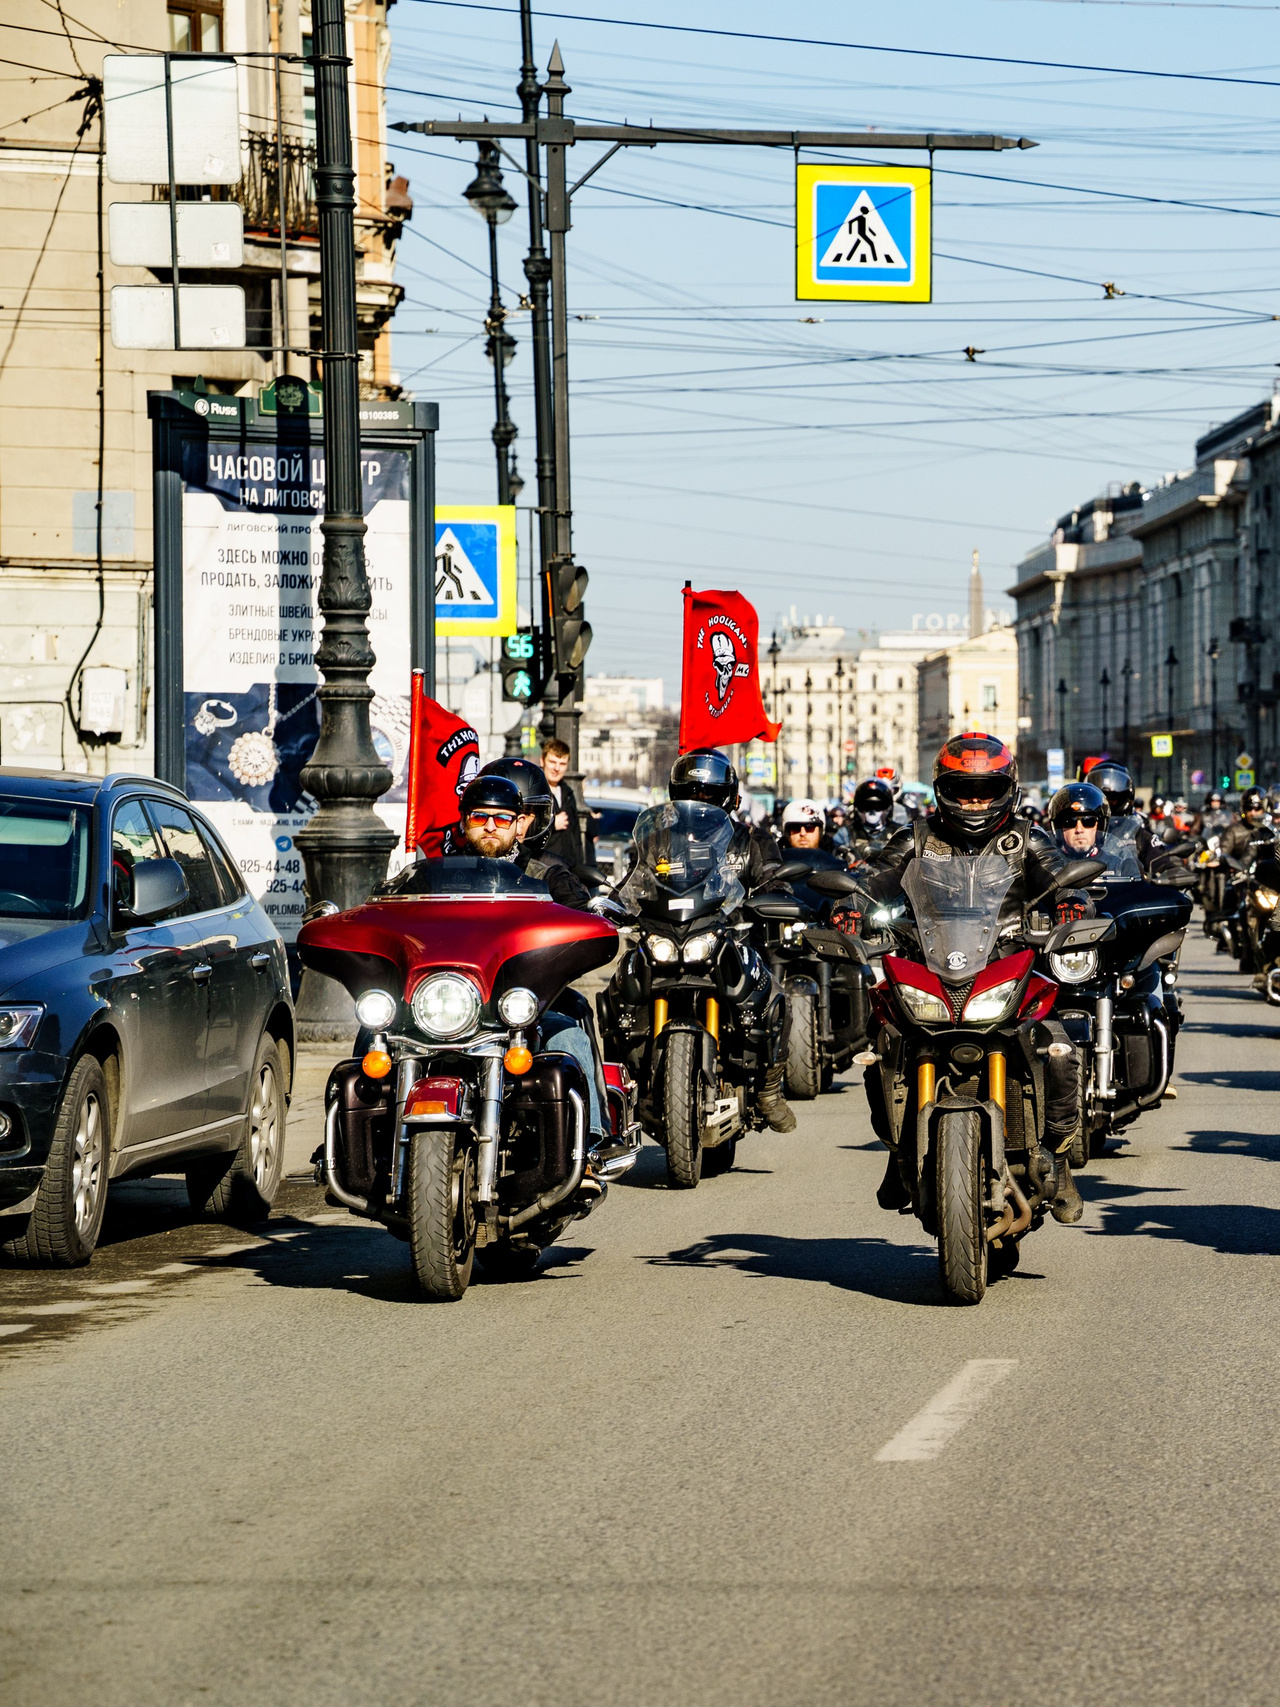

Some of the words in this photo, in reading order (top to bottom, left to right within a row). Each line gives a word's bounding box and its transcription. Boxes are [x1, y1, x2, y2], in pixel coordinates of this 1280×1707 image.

[209, 453, 304, 482] ЧАСОВОЙ
[312, 458, 381, 486] ЦТР
[239, 488, 259, 506] НА
[263, 489, 326, 509] ЛИГОВСК
[227, 523, 288, 534] ЛИГОВСКИЙ
[291, 525, 320, 535] ПРОС
[218, 548, 257, 564] ЗДЕСЬ
[261, 550, 308, 566] МОЖНО
[201, 571, 261, 589] ПРОДАТЬ,
[264, 573, 321, 589] ЗАЛОЖИ
[228, 604, 276, 618] ЭЛИТНЫЕ
[228, 627, 289, 642] БРЕНДОВЫЕ
[507, 634, 534, 658] 56
[229, 651, 276, 665] ИЗДЕЛИЯ
[279, 652, 286, 665] С
[441, 735, 463, 757] THE
[240, 859, 300, 873] 925-44-48
[263, 904, 306, 915] VIPLOMBA
